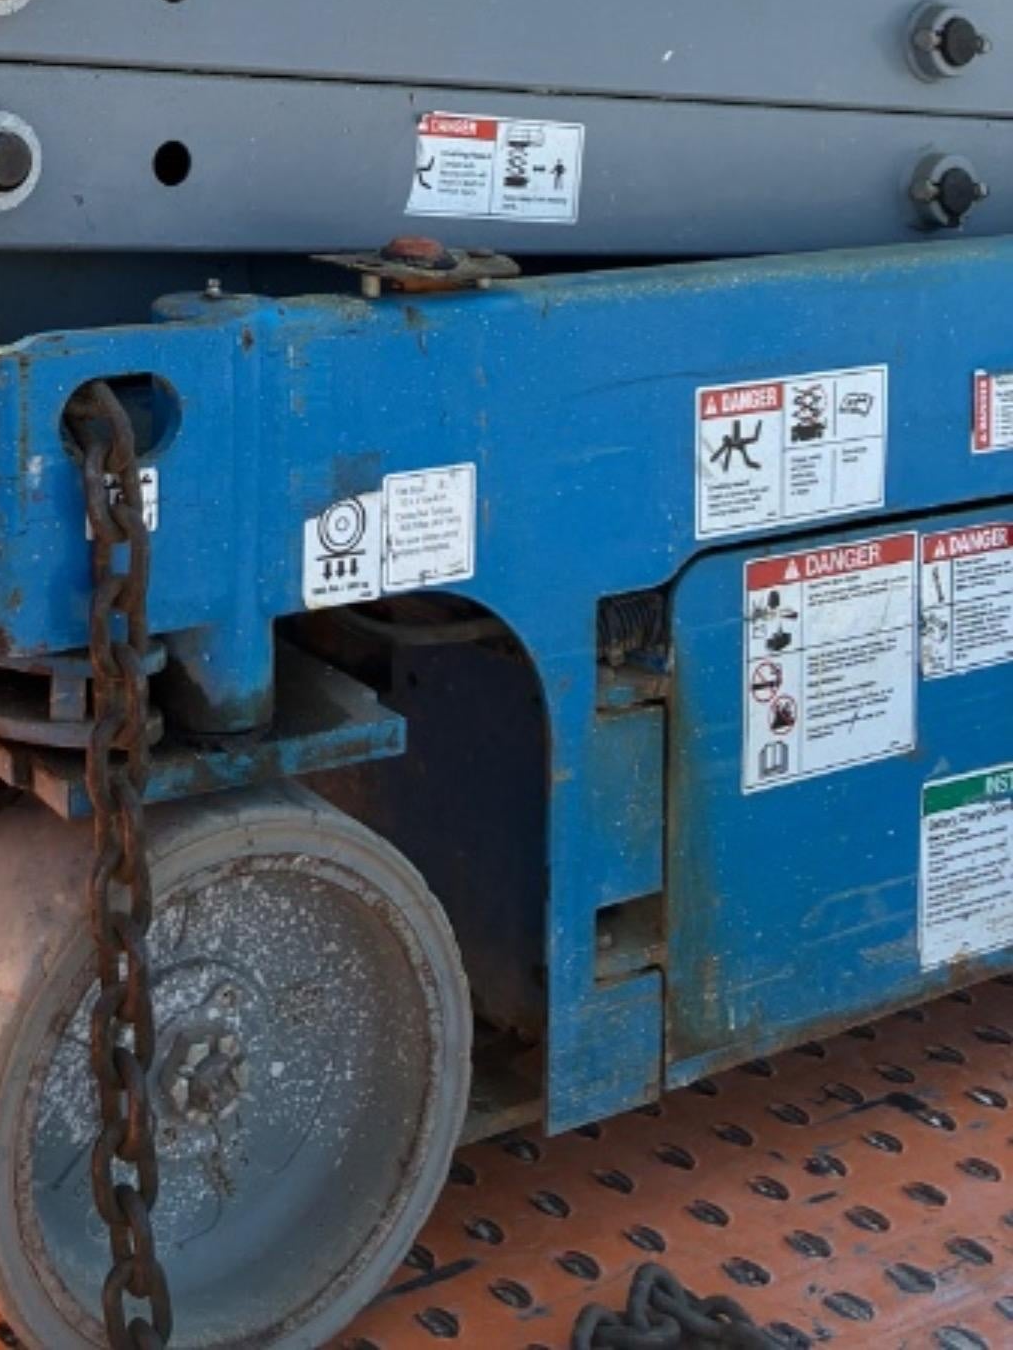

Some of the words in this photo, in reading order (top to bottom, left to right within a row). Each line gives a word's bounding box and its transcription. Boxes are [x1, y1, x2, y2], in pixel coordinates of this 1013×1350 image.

[721, 386, 779, 413] DANGER
[949, 525, 1008, 556] DANGER
[805, 542, 882, 578] DANGER
